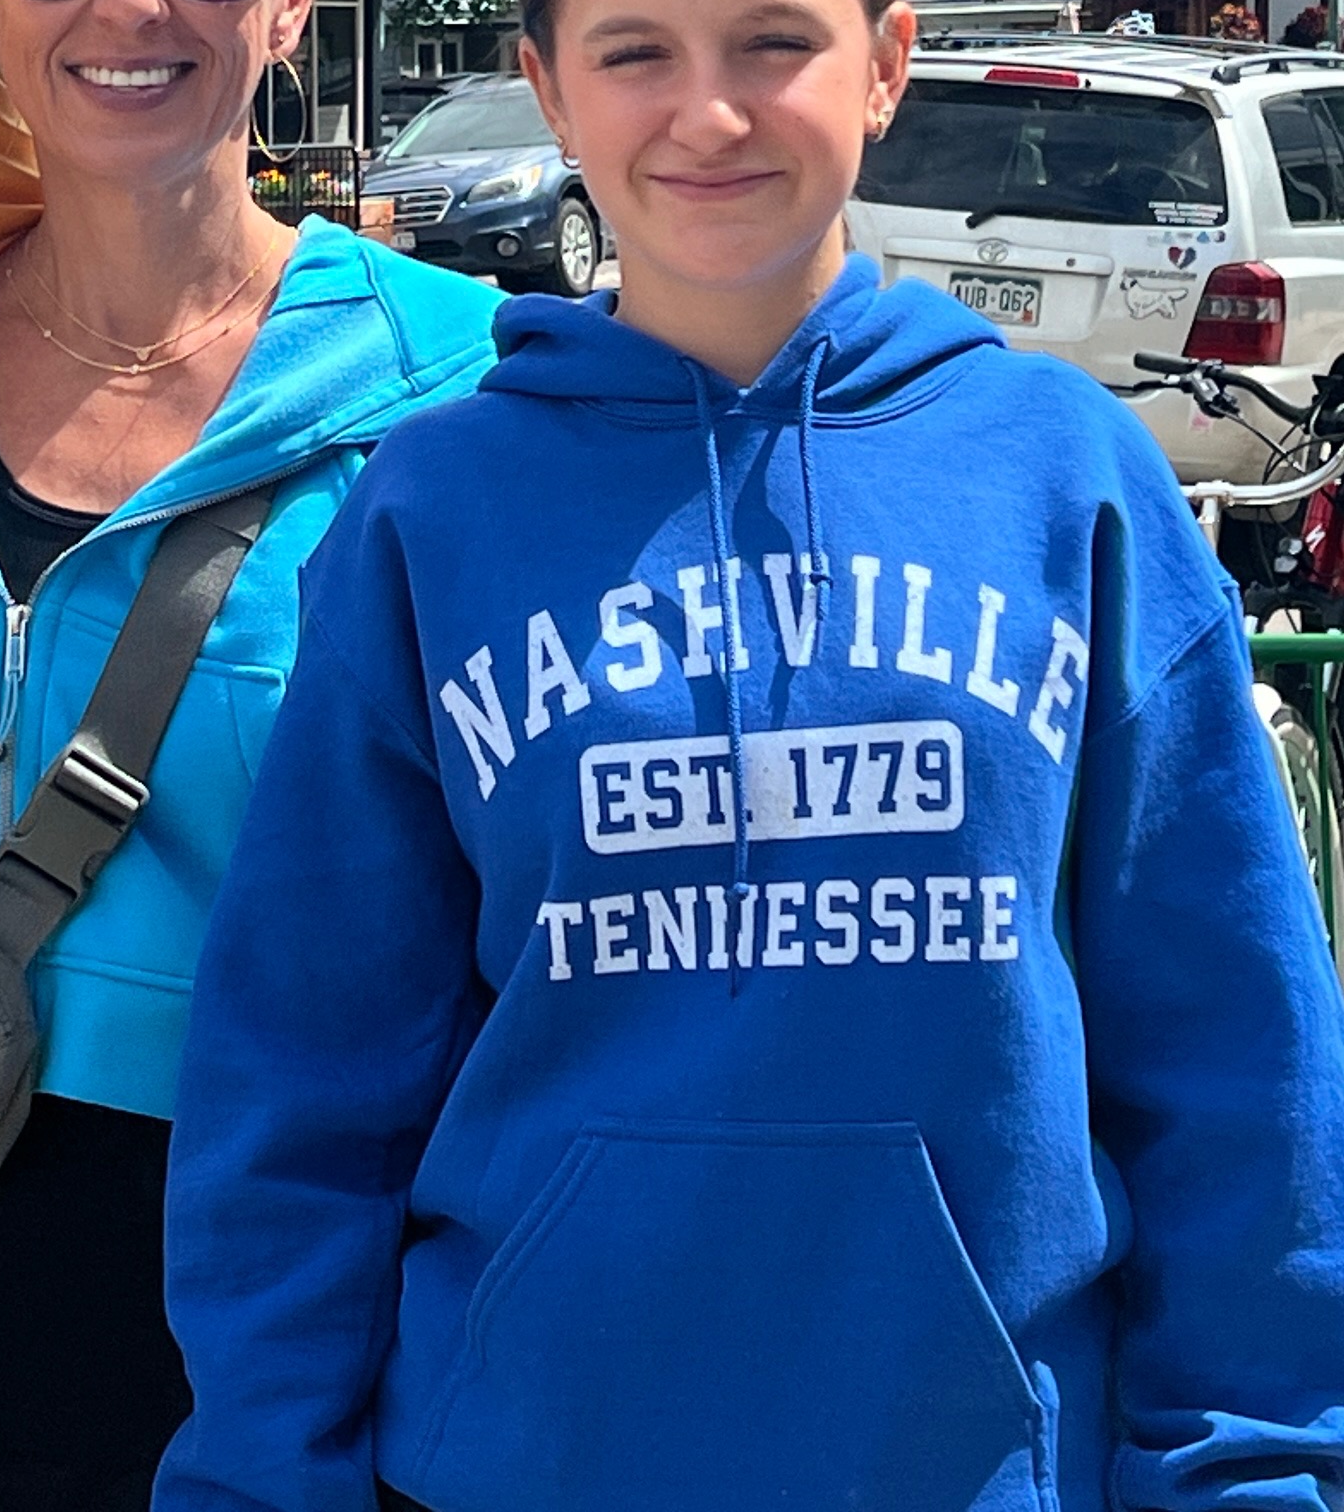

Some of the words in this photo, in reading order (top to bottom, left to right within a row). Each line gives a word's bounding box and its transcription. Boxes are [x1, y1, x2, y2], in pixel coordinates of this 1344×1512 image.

[440, 552, 1090, 801] NASHVILLE
[787, 738, 952, 820] 1779
[536, 875, 1020, 981] TENNESSEE
